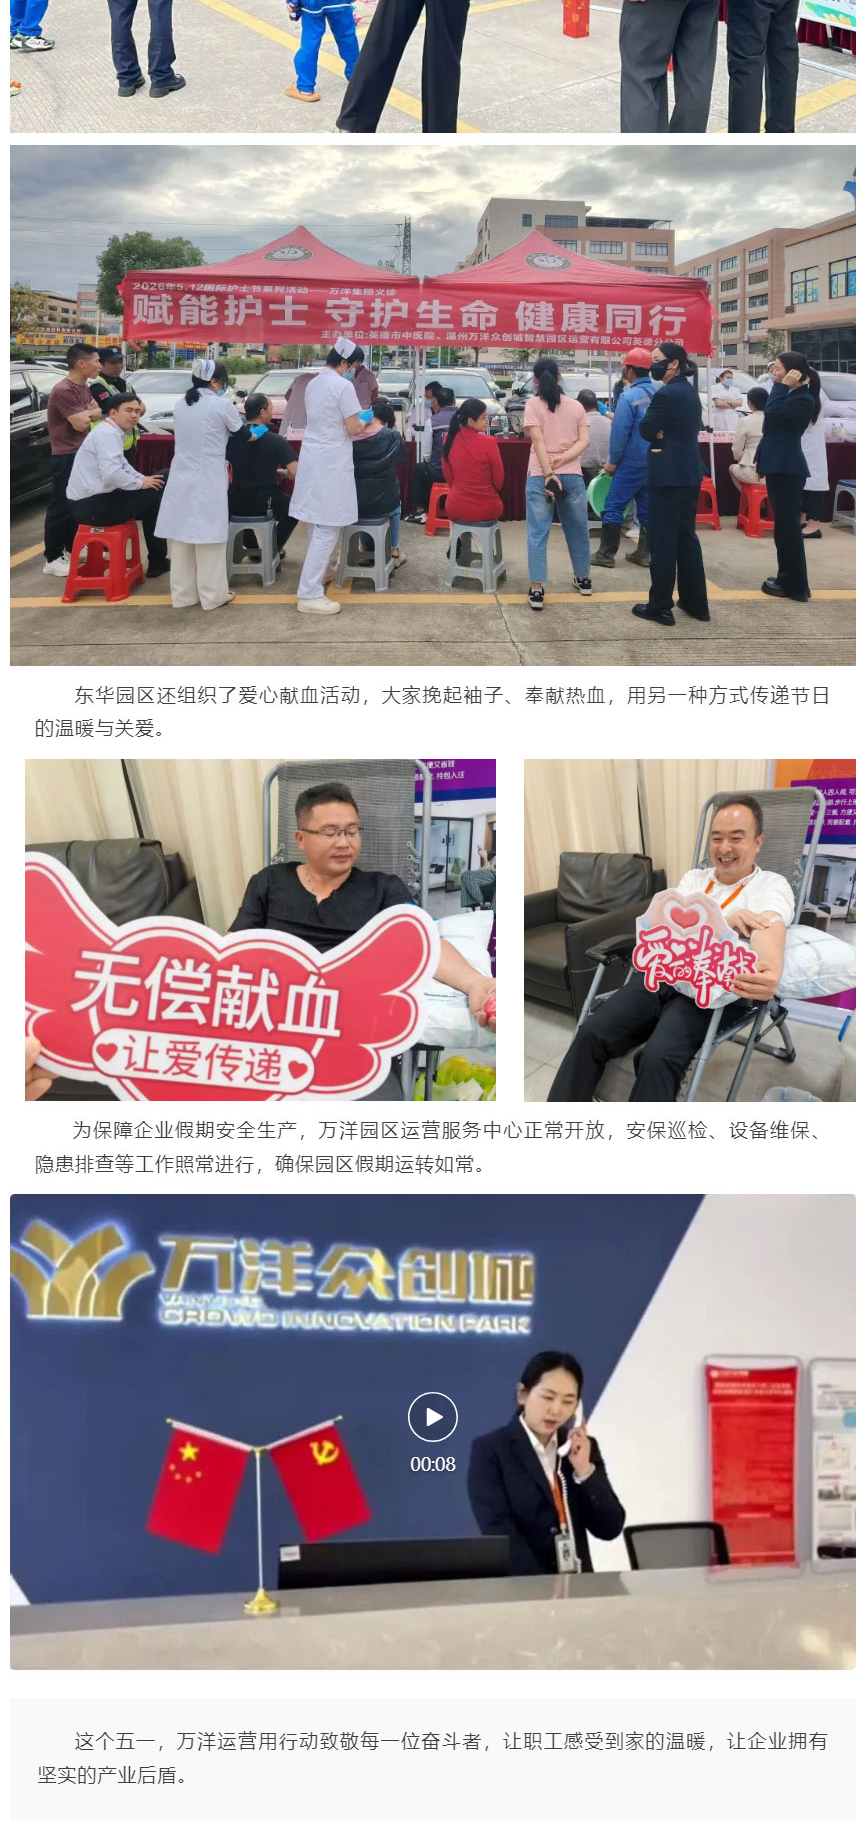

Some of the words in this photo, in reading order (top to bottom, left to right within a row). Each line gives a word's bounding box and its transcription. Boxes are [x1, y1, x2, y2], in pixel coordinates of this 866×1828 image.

[132, 293, 309, 327] 赋能护士
[324, 297, 499, 332] 守护生命
[515, 300, 687, 336] 健康同行
[70, 949, 342, 1038] 无偿献血
[122, 1033, 283, 1086] 让爱传递
[160, 1234, 534, 1305] 万洋众创城
[160, 1308, 279, 1327] CROWD
[281, 1309, 456, 1332] INNOVATION
[459, 1313, 532, 1334] PARK
